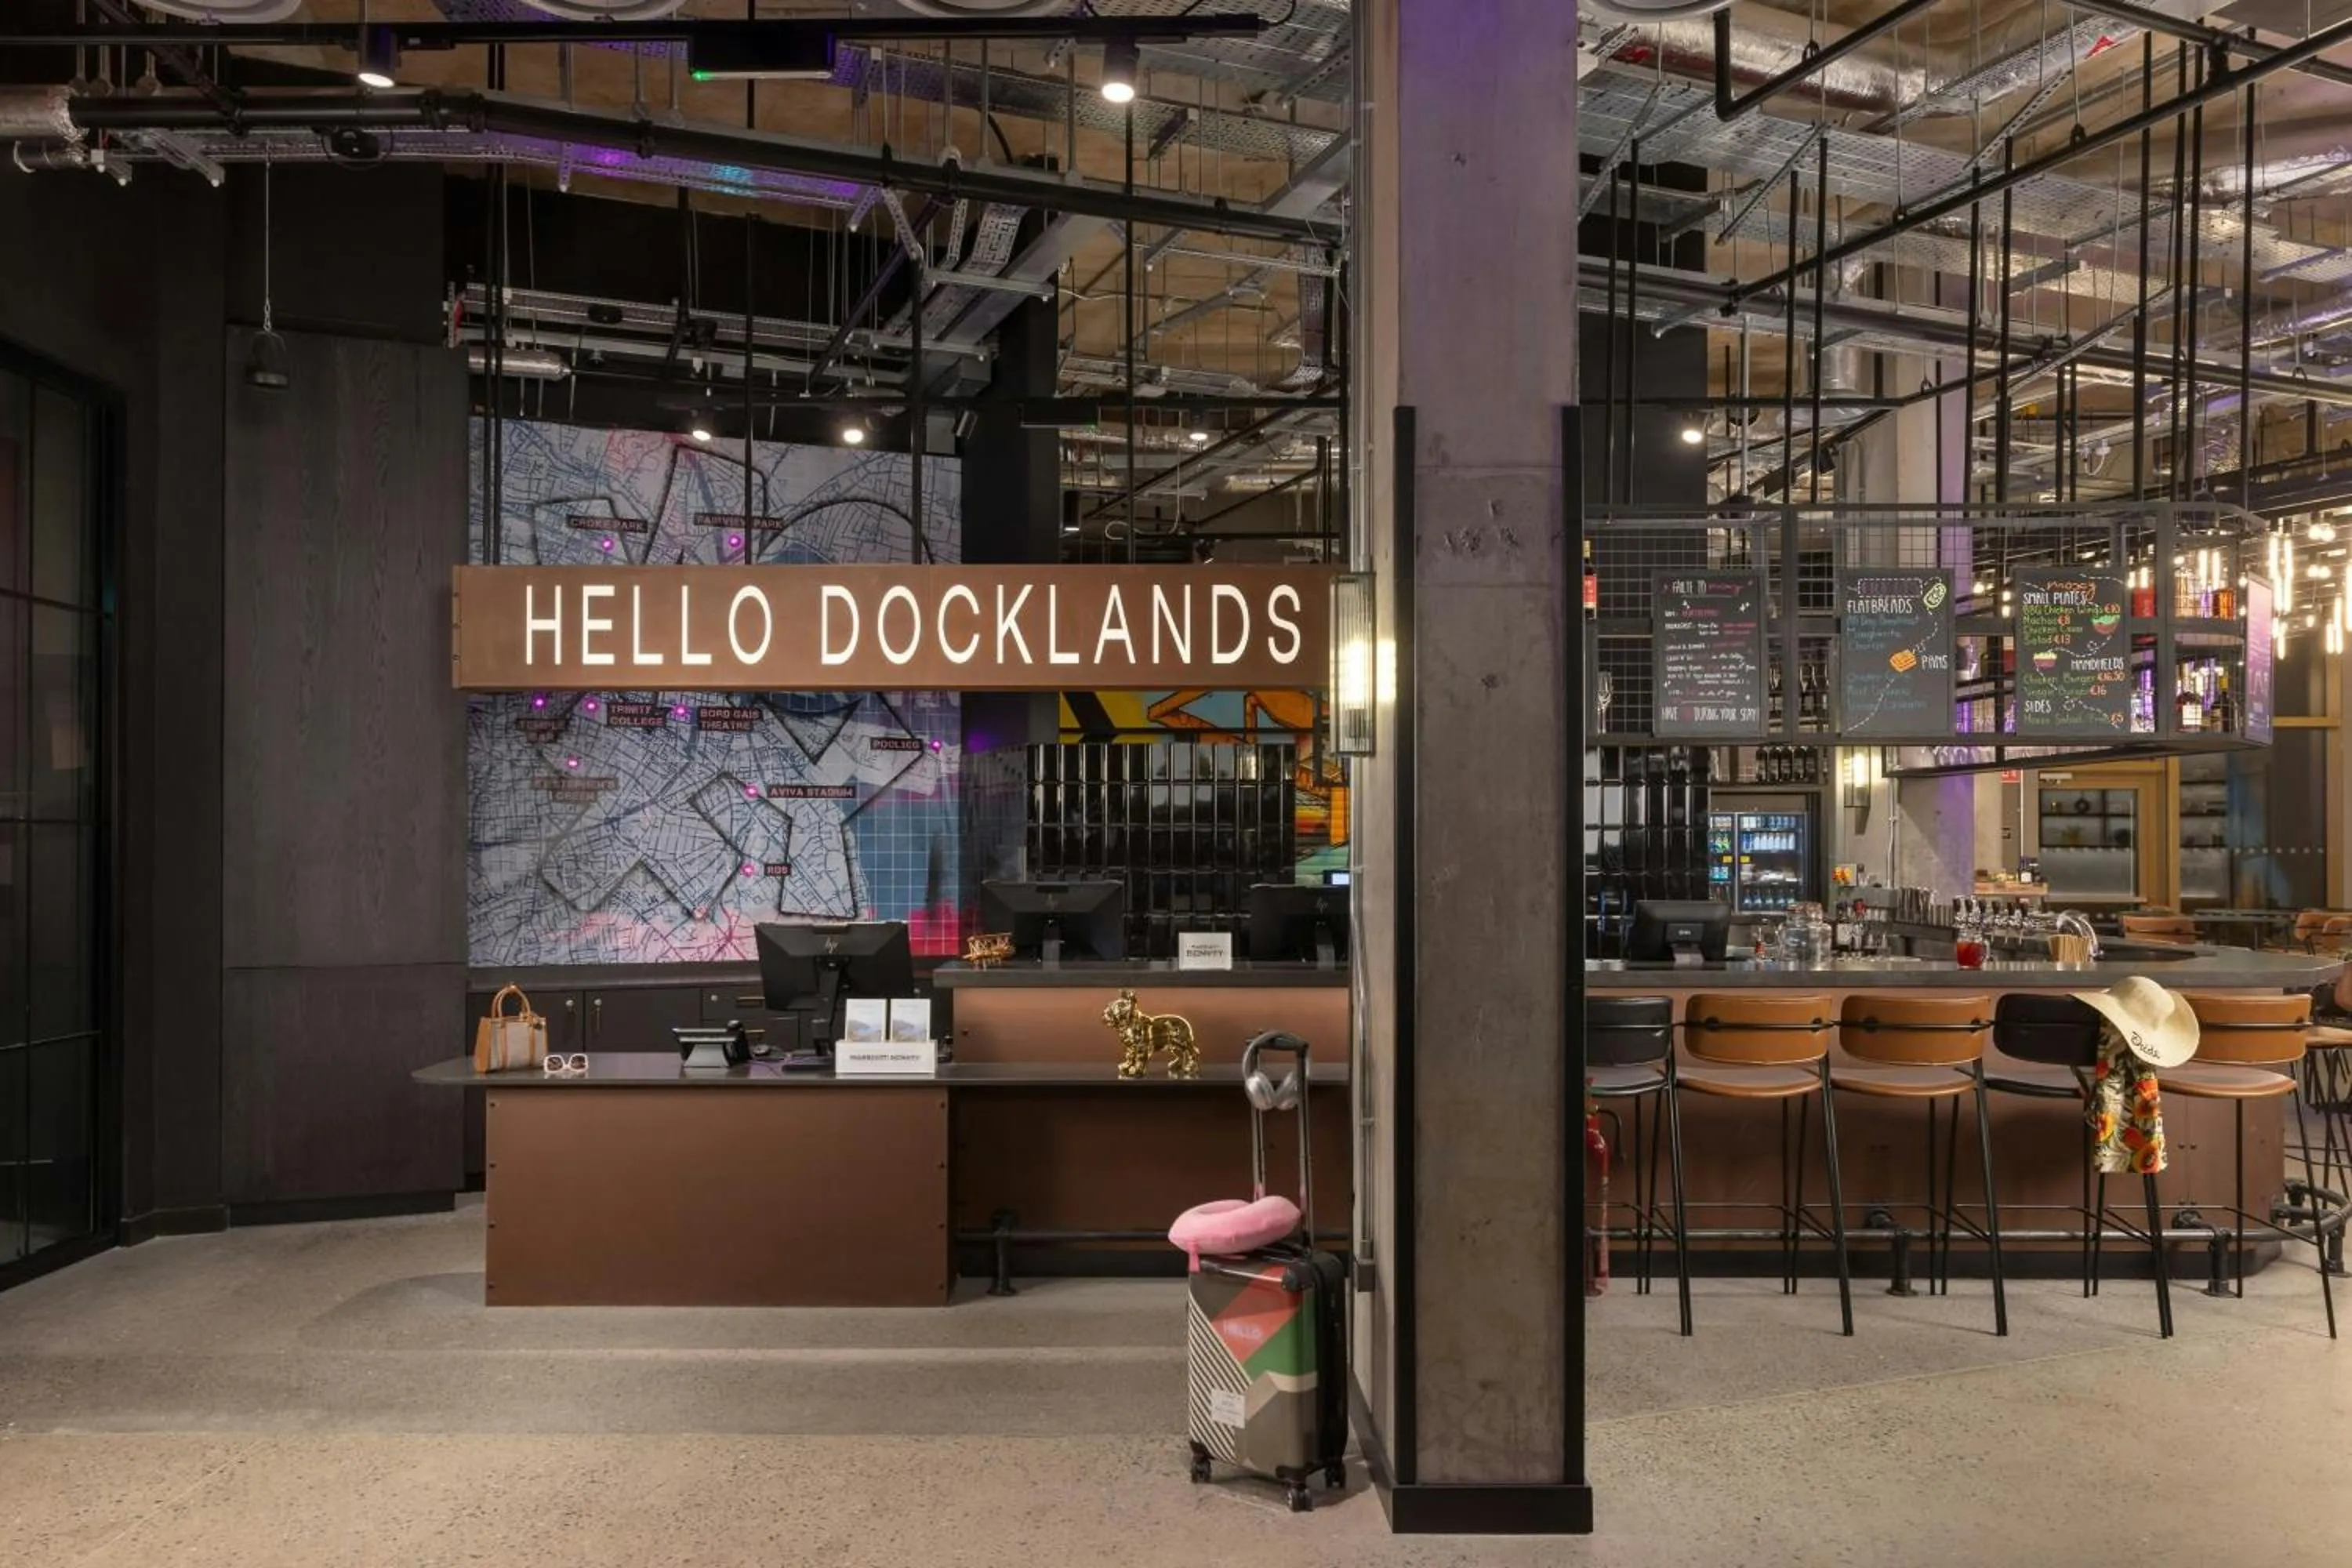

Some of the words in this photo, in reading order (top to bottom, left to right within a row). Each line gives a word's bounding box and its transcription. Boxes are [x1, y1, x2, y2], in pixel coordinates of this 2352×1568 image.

[614, 520, 644, 532] PARK
[753, 518, 782, 529] PARK
[1847, 598, 1912, 613] FLATBREADS
[525, 584, 772, 665] HELLO
[820, 584, 1301, 665] DOCKLANDS
[611, 705, 652, 715] TRINITY
[2024, 699, 2052, 713] SIDES
[610, 716, 665, 727] COLLEGE
[700, 720, 750, 730] THEATRE
[770, 787, 804, 797] AVIVA
[806, 787, 853, 797] STADIUM
